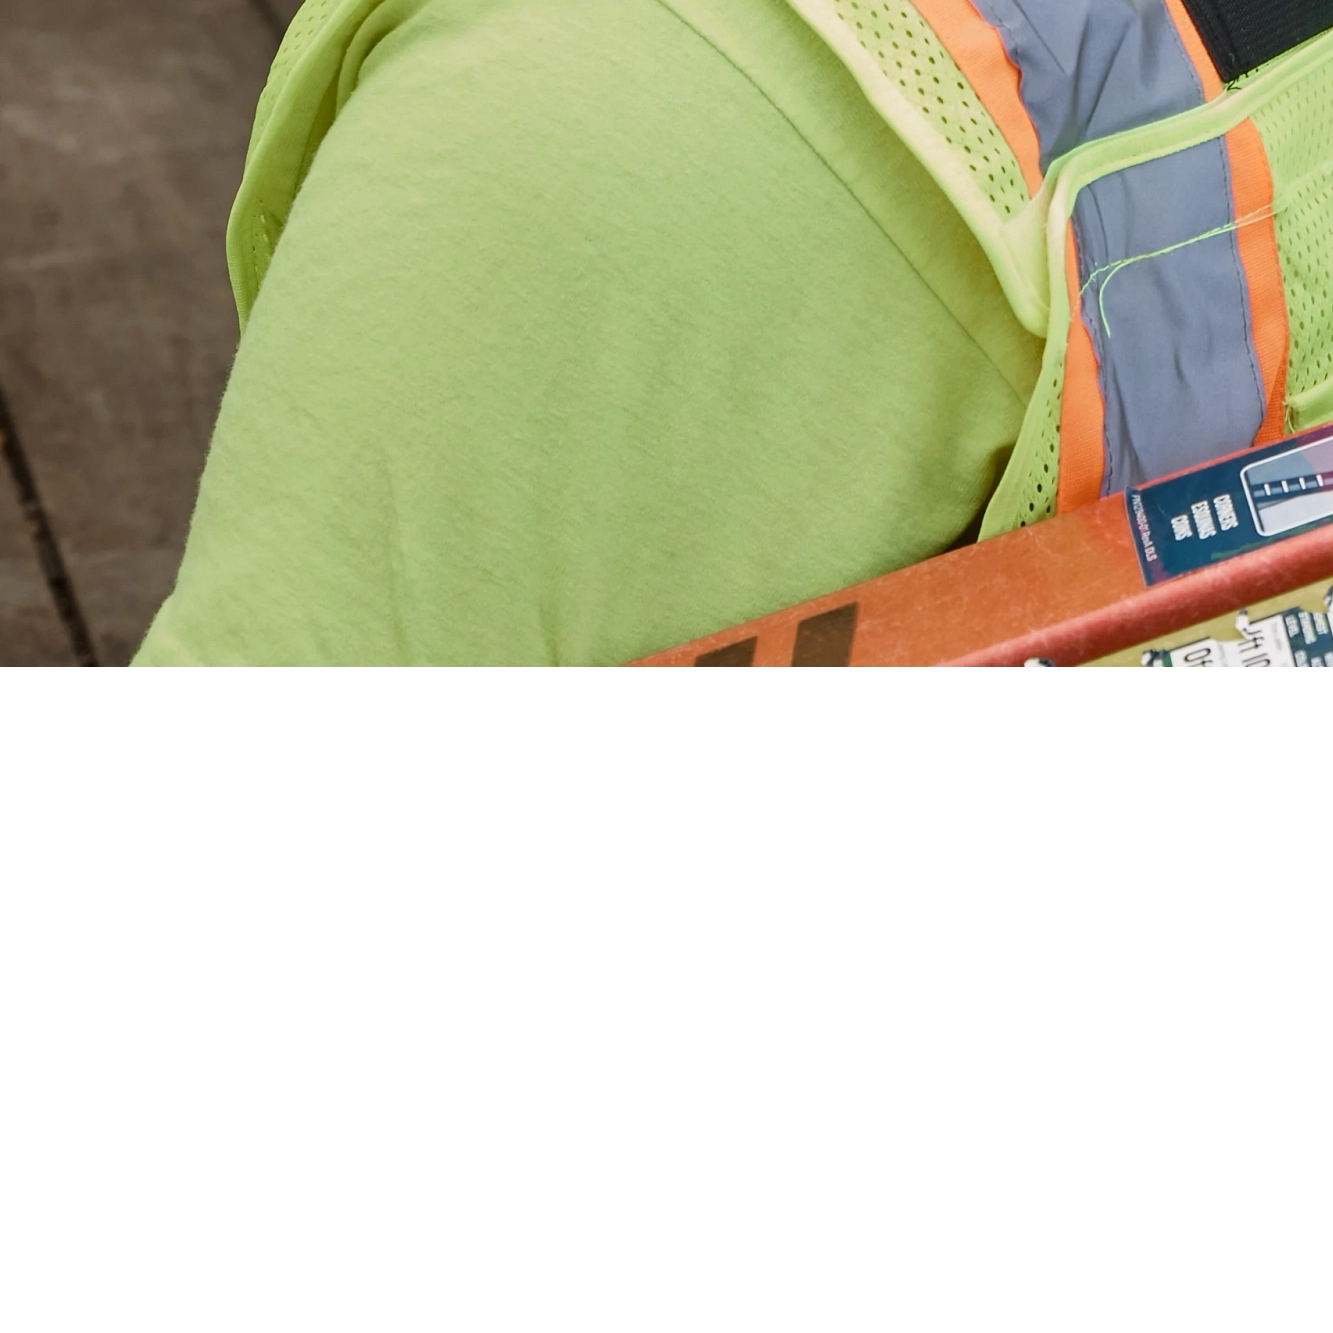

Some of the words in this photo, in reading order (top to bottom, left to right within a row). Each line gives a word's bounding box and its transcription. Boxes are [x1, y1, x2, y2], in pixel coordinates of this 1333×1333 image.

[1171, 515, 1190, 541] COINS
[1190, 500, 1217, 539] ESQUINAS
[1213, 494, 1238, 531] CORNERS
